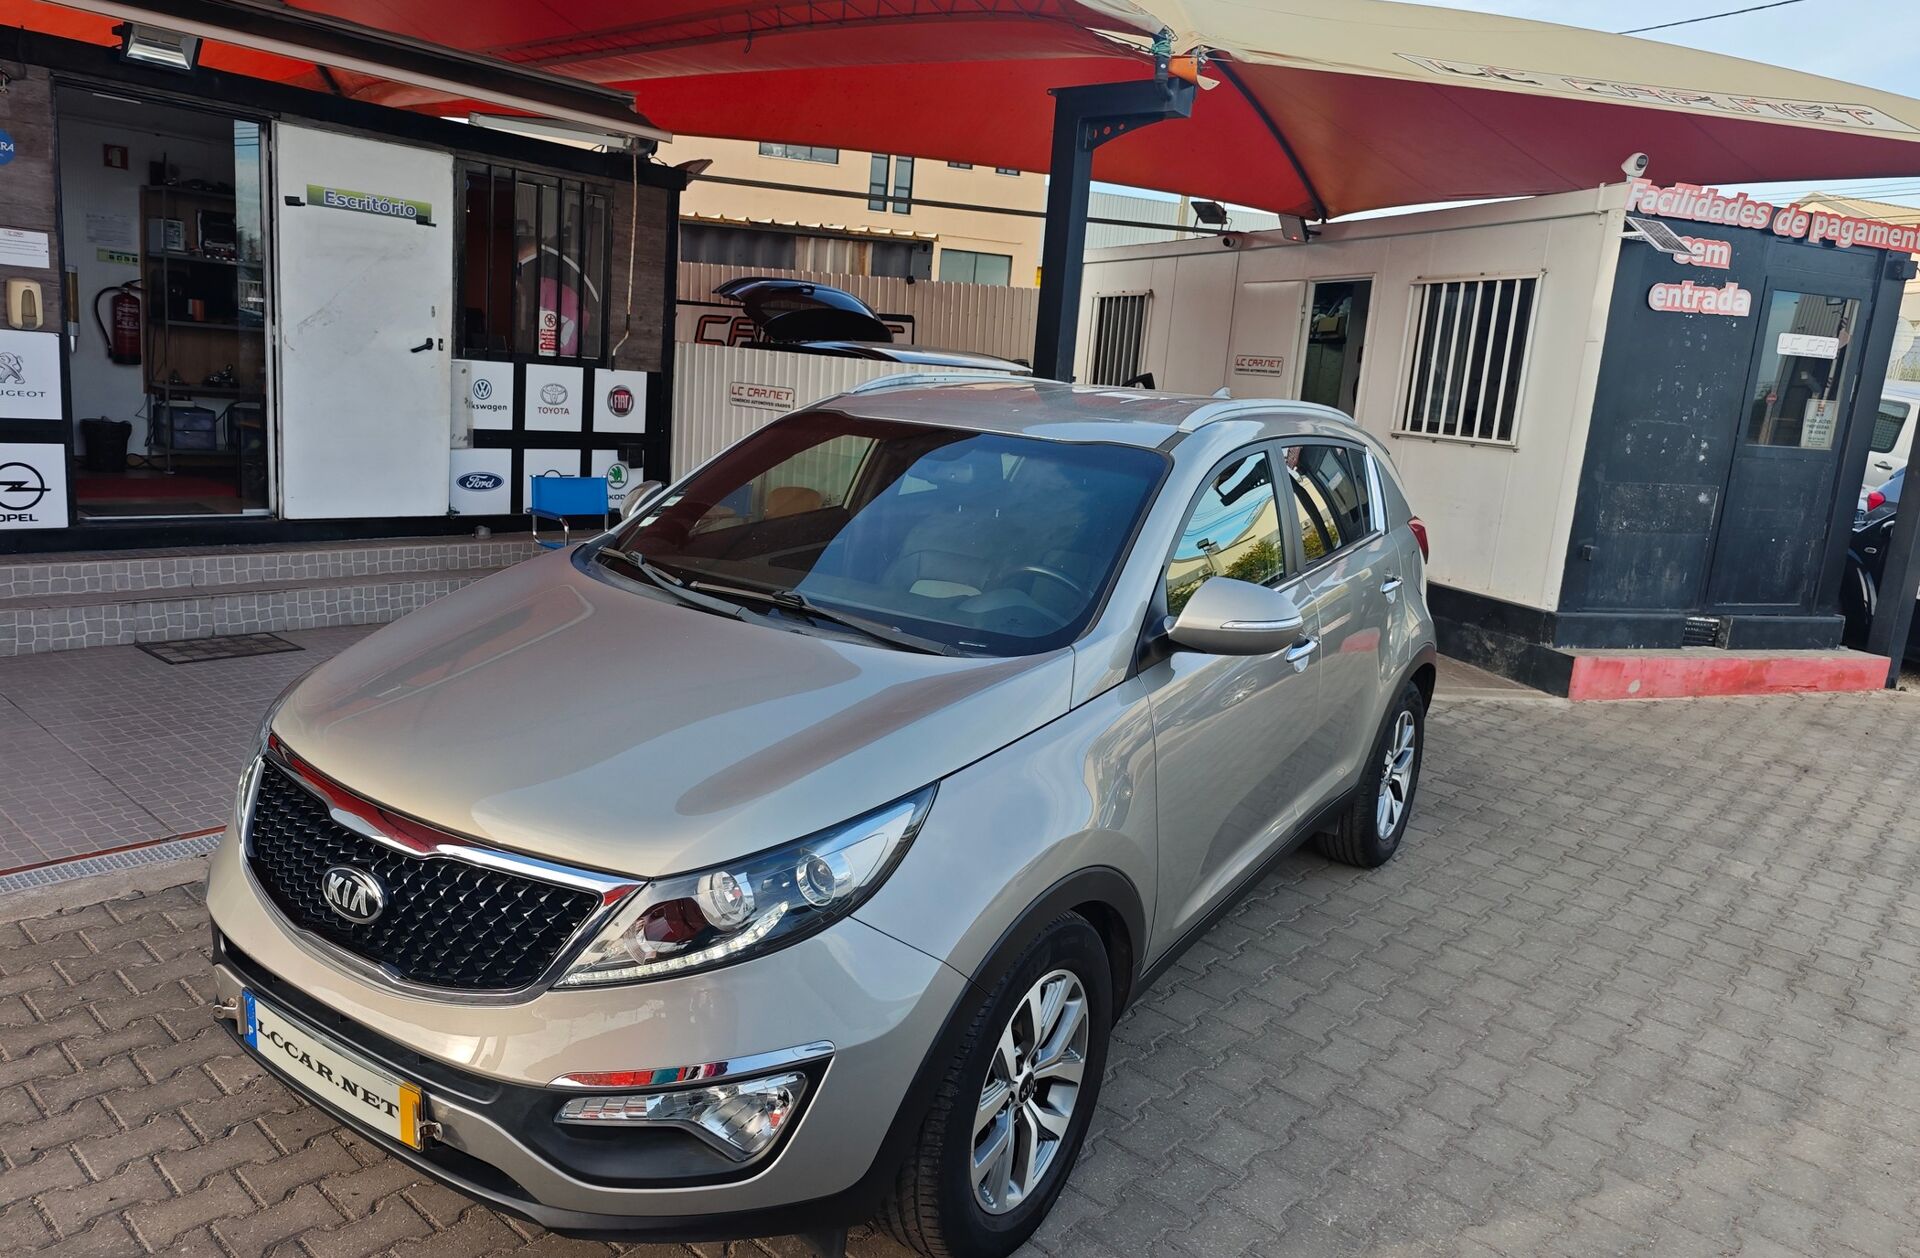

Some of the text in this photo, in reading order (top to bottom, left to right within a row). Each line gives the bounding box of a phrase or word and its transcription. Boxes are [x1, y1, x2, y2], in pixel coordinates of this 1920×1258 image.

[324, 190, 416, 217] Escritório
[1627, 181, 1771, 226] Facilidades
[1776, 206, 1808, 234] de
[1652, 283, 1750, 315] entrada
[614, 394, 630, 409] FIAT
[731, 386, 744, 396] LC
[466, 400, 508, 412] lkswagen
[537, 406, 570, 415] TOYOTA
[466, 474, 495, 488] Ford
[327, 873, 369, 916] KIA
[257, 1018, 400, 1120] LCCAR.NET
